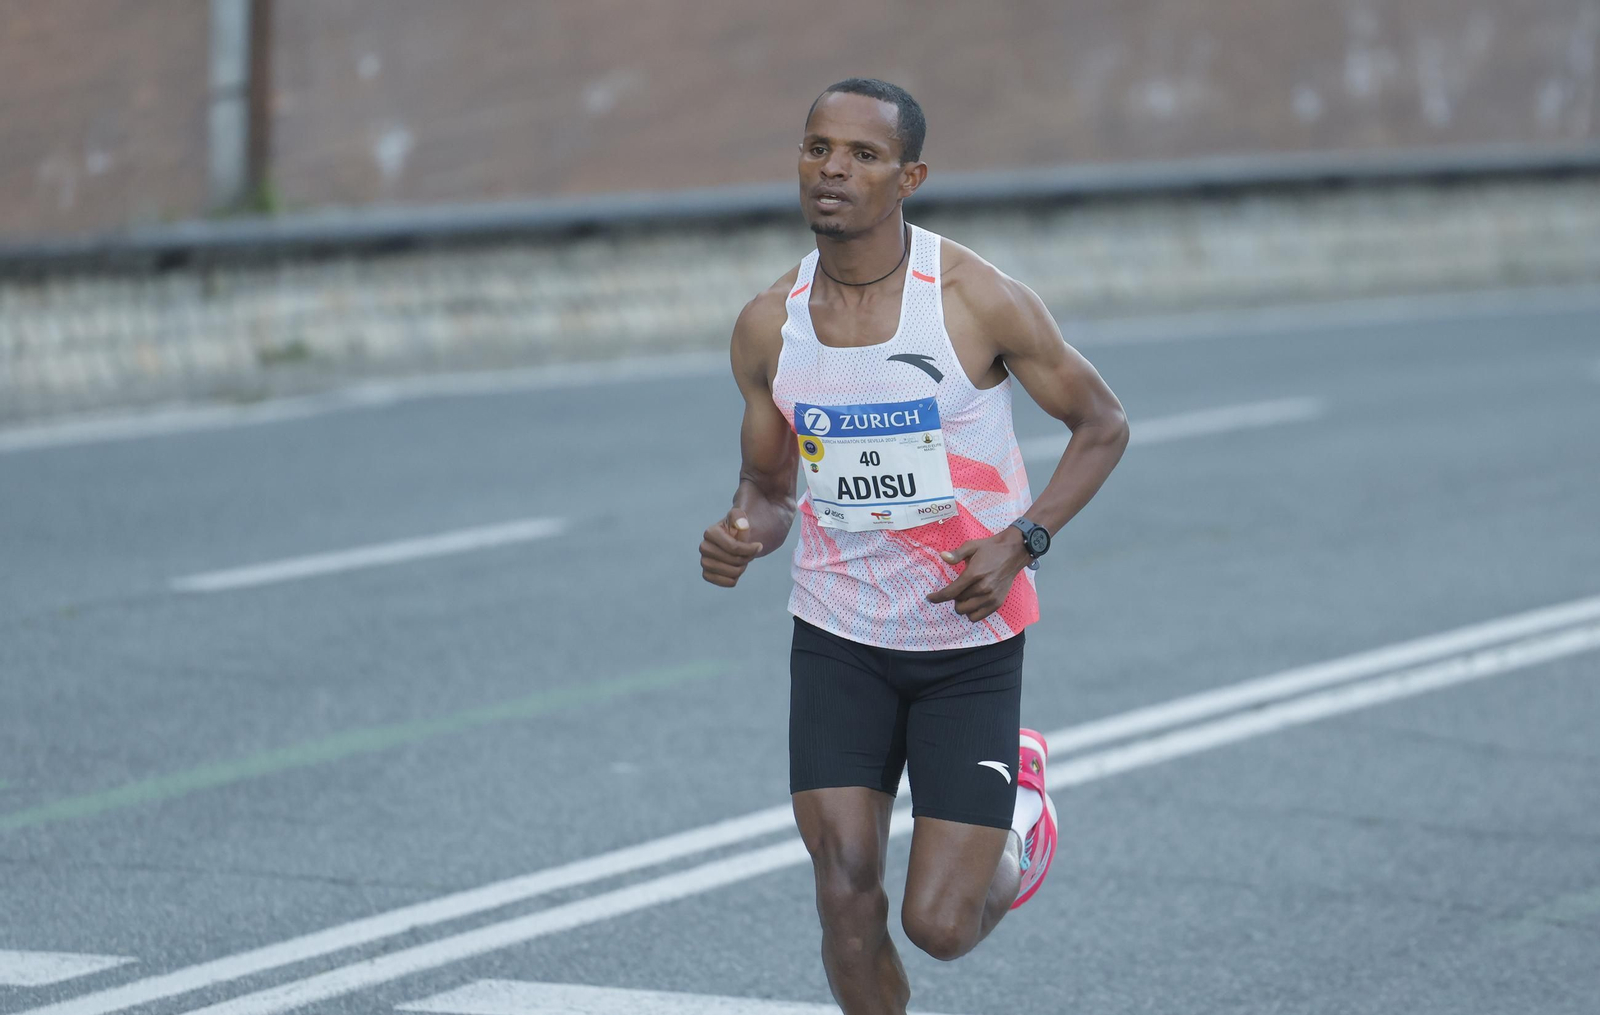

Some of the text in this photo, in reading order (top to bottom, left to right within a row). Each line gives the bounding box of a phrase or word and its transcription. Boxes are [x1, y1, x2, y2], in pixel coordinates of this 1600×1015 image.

[839, 410, 921, 430] ZURICH
[859, 450, 881, 467] 40
[837, 473, 917, 500] ADISU
